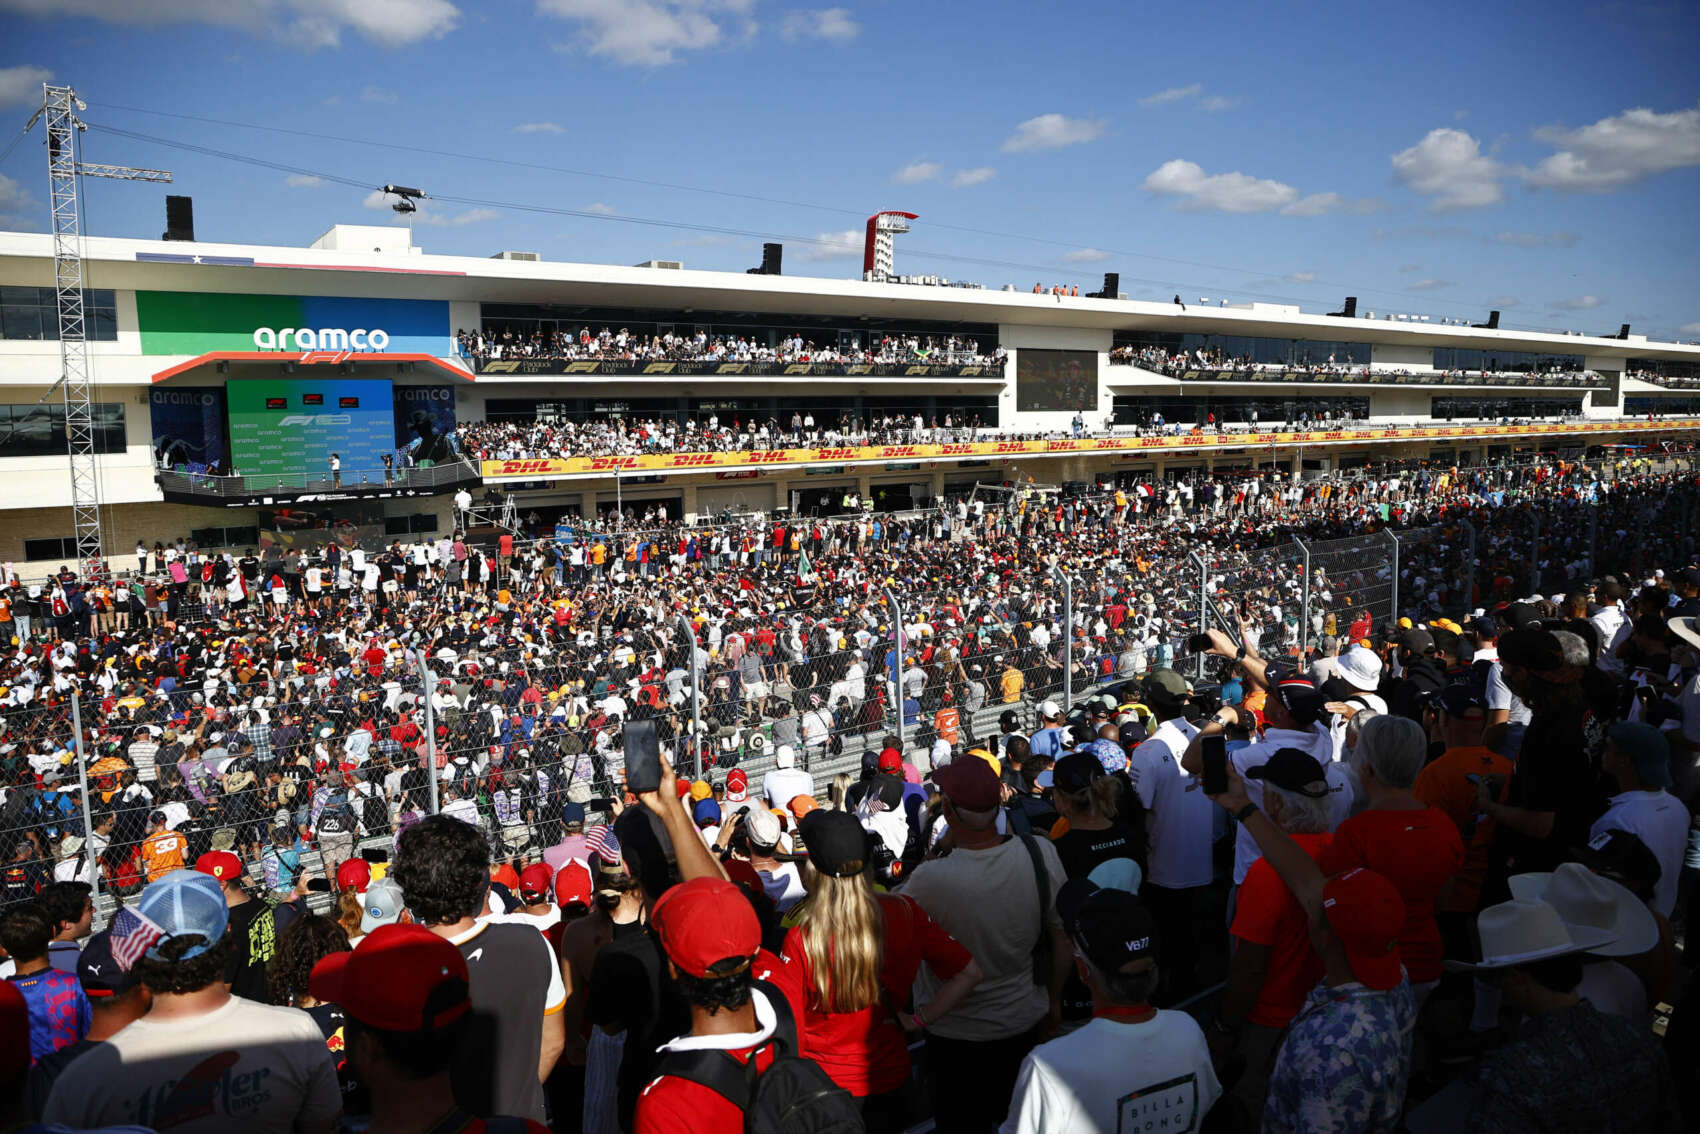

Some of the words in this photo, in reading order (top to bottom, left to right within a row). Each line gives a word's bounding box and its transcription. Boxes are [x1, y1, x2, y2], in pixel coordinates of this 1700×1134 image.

[253, 326, 390, 350] aramco
[482, 361, 521, 373] F1
[563, 361, 600, 373] F1
[643, 362, 678, 374] F1
[716, 363, 748, 374] F1
[152, 390, 215, 406] aramco
[396, 388, 451, 401] ramco
[1183, 437, 1205, 445] DHL
[1258, 434, 1278, 442] DHL
[1293, 433, 1312, 441] DHL
[1325, 432, 1342, 440] DHL
[998, 442, 1026, 451] DHL
[1050, 441, 1077, 450] DHL
[1097, 440, 1122, 448] DHL
[1140, 438, 1164, 447] DHL
[818, 449, 854, 459] DHL
[882, 446, 916, 457] DHL
[942, 444, 972, 454] DHL
[673, 454, 716, 466] DHL
[749, 451, 788, 462] DHL
[502, 460, 552, 473] DHL
[592, 457, 638, 470] DHL
[323, 818, 341, 831] 226
[154, 837, 179, 855] 33
[1125, 936, 1150, 952] VB77
[1131, 1095, 1185, 1119] BILLA
